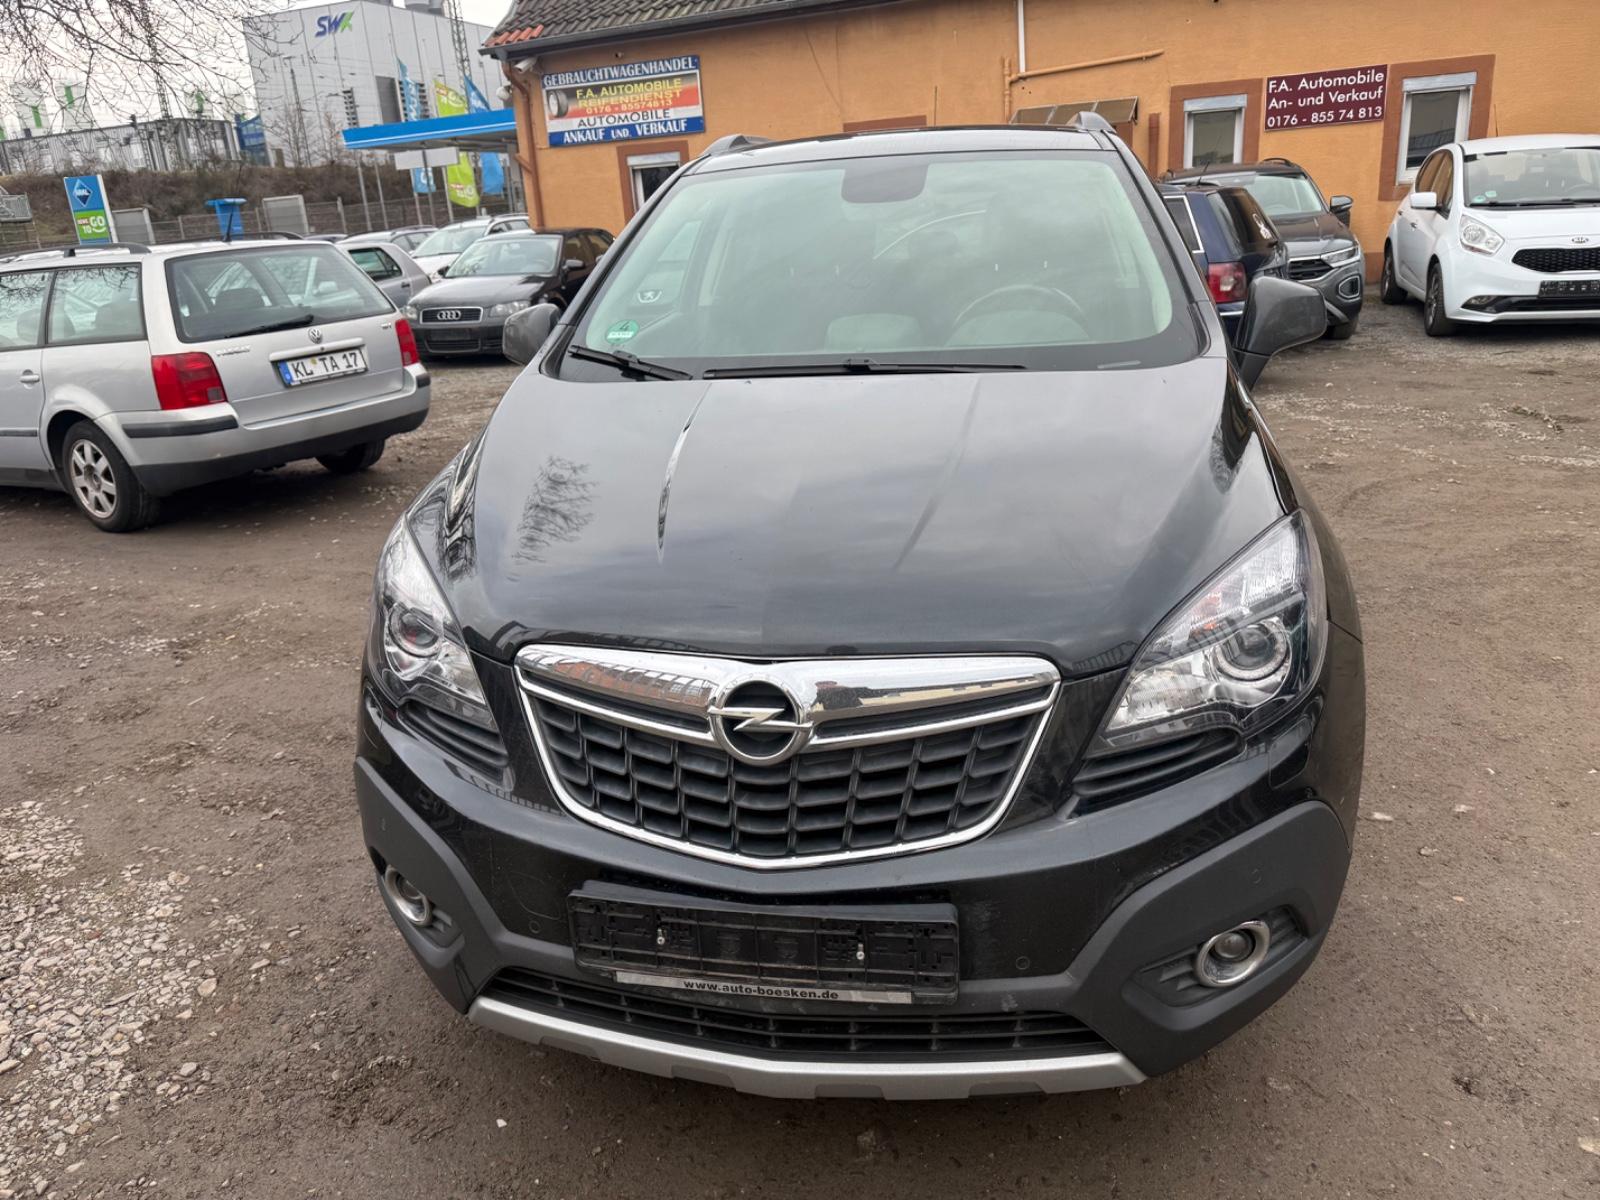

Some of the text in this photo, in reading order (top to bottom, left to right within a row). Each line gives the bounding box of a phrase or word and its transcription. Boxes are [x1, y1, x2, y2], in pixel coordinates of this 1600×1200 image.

[544, 56, 696, 87] GEBRAUCHTWAGENHANDEL
[1268, 69, 1385, 93] F.A. Automobile
[576, 78, 682, 100] F.A. AUTOMOBILE
[578, 88, 683, 109] REIFENDIENST
[1268, 86, 1384, 110] An- und Verkauf
[577, 109, 671, 128] AUTOMOBILE
[1267, 114, 1298, 128] 0176
[1311, 111, 1334, 123] 855
[1339, 109, 1354, 121] 74
[1358, 106, 1382, 118] 813
[563, 129, 606, 144] ANKAUF
[635, 119, 688, 136] VERKAUF
[292, 361, 314, 378] KL
[319, 355, 340, 373] TA
[342, 352, 358, 369] 17
[683, 979, 839, 1000] www.auto-boesken.de
